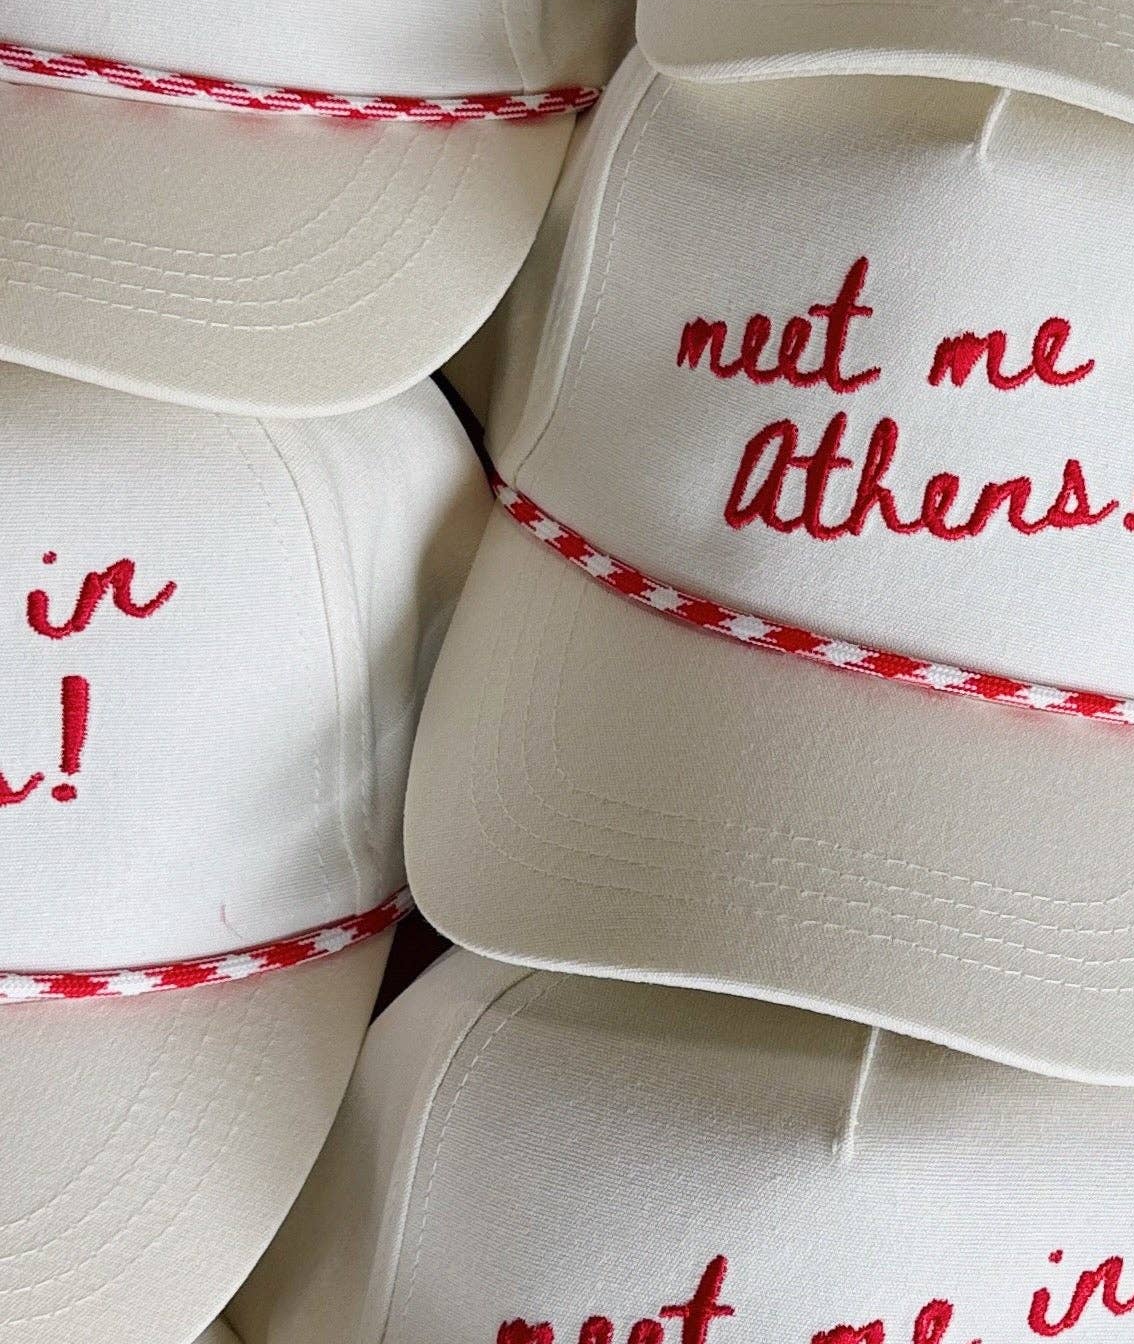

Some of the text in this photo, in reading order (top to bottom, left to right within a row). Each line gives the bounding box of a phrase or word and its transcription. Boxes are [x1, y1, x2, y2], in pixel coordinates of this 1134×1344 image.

[678, 257, 881, 394] meet
[928, 317, 1094, 391] me
[27, 552, 176, 639] in
